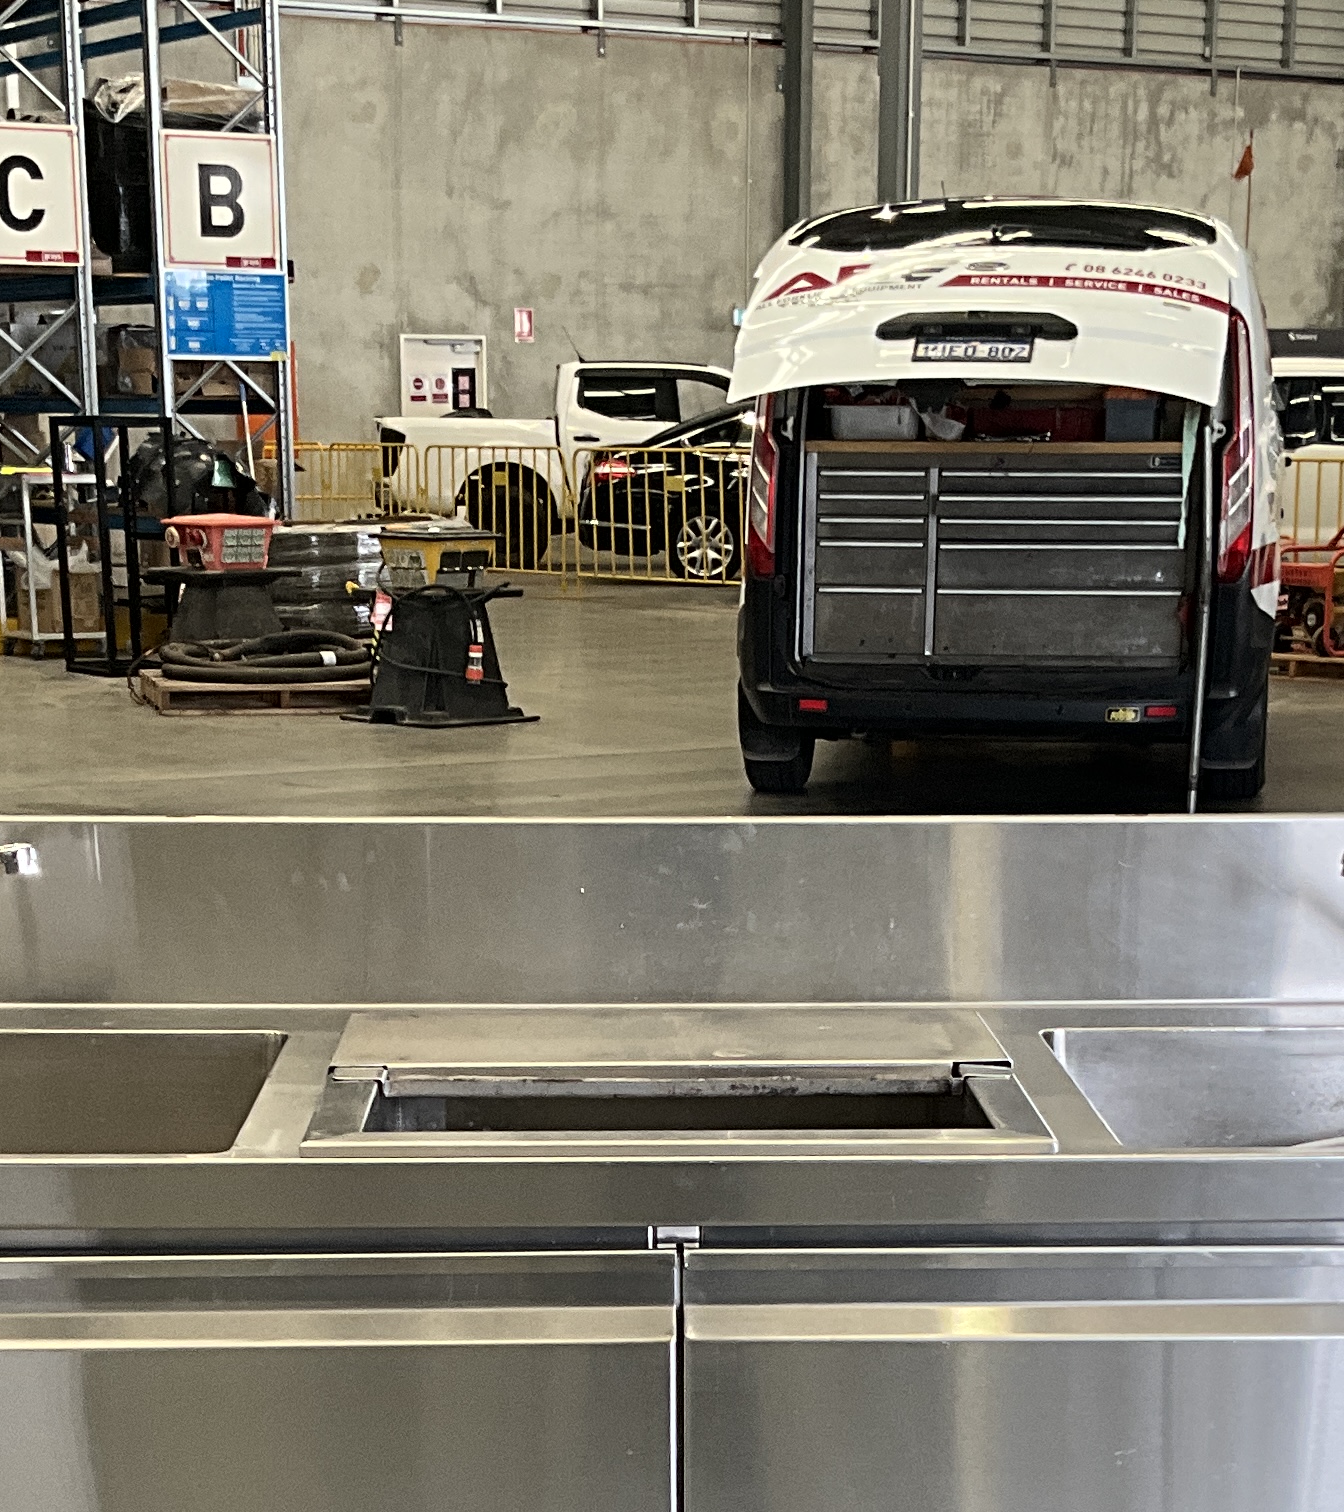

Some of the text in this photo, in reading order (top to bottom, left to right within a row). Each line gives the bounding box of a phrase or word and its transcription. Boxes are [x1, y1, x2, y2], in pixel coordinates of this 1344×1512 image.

[197, 162, 245, 238] B
[969, 276, 1201, 303] RENTALS SERVICE SALES
[1083, 264, 1106, 274] 08
[1162, 273, 1206, 290] 0233
